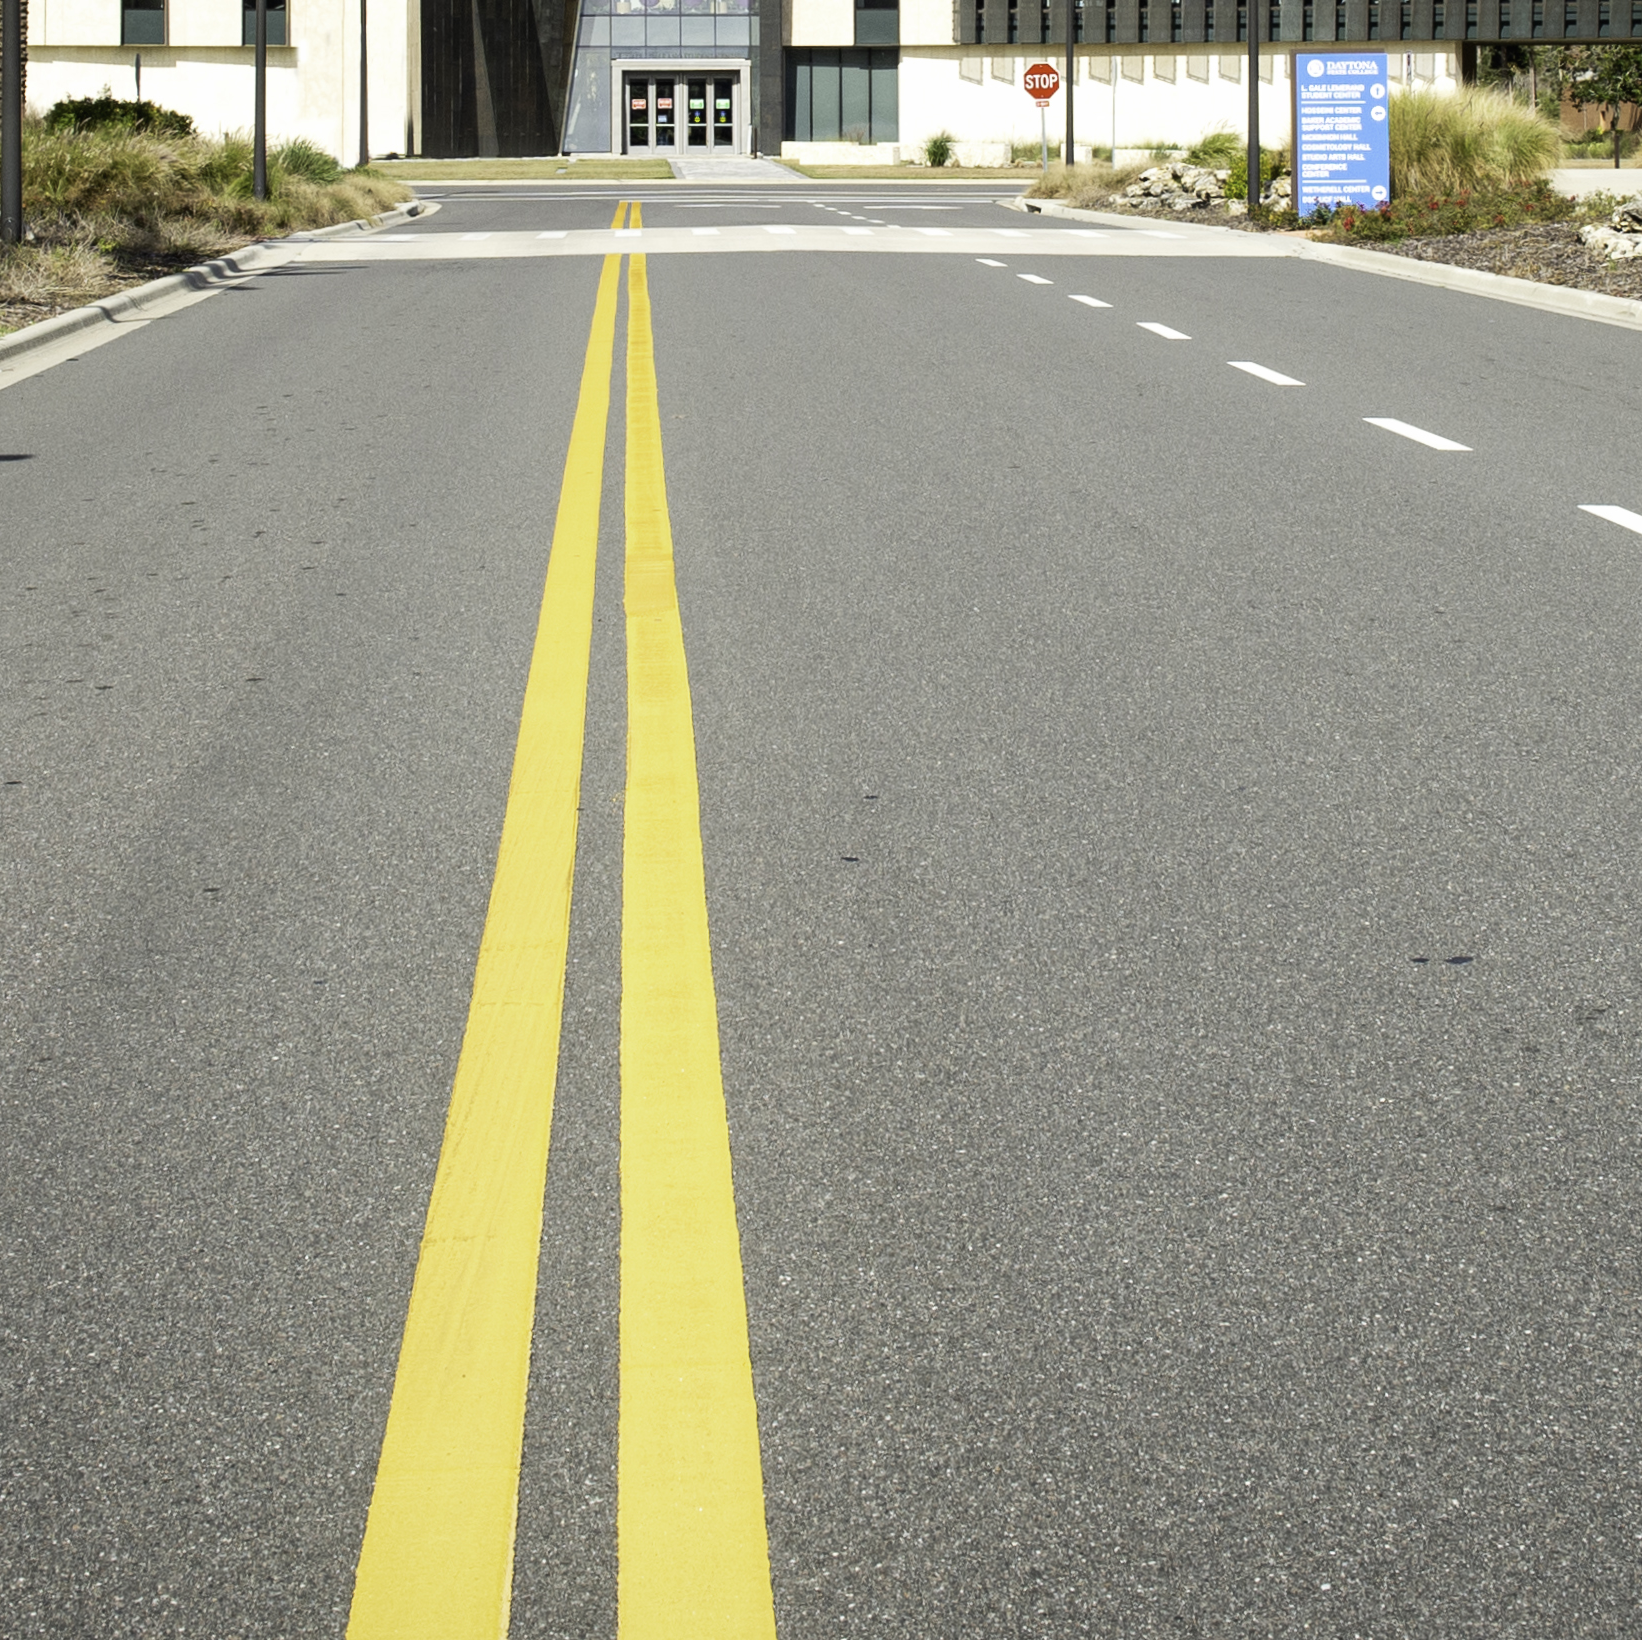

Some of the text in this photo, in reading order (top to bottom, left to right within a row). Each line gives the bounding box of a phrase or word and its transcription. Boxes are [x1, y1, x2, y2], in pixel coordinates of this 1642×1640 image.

[1326, 61, 1378, 69] DAYTONA
[1025, 74, 1058, 89] STOP
[1302, 163, 1347, 171] CONFERENCE
[1343, 185, 1371, 193] CENTER
